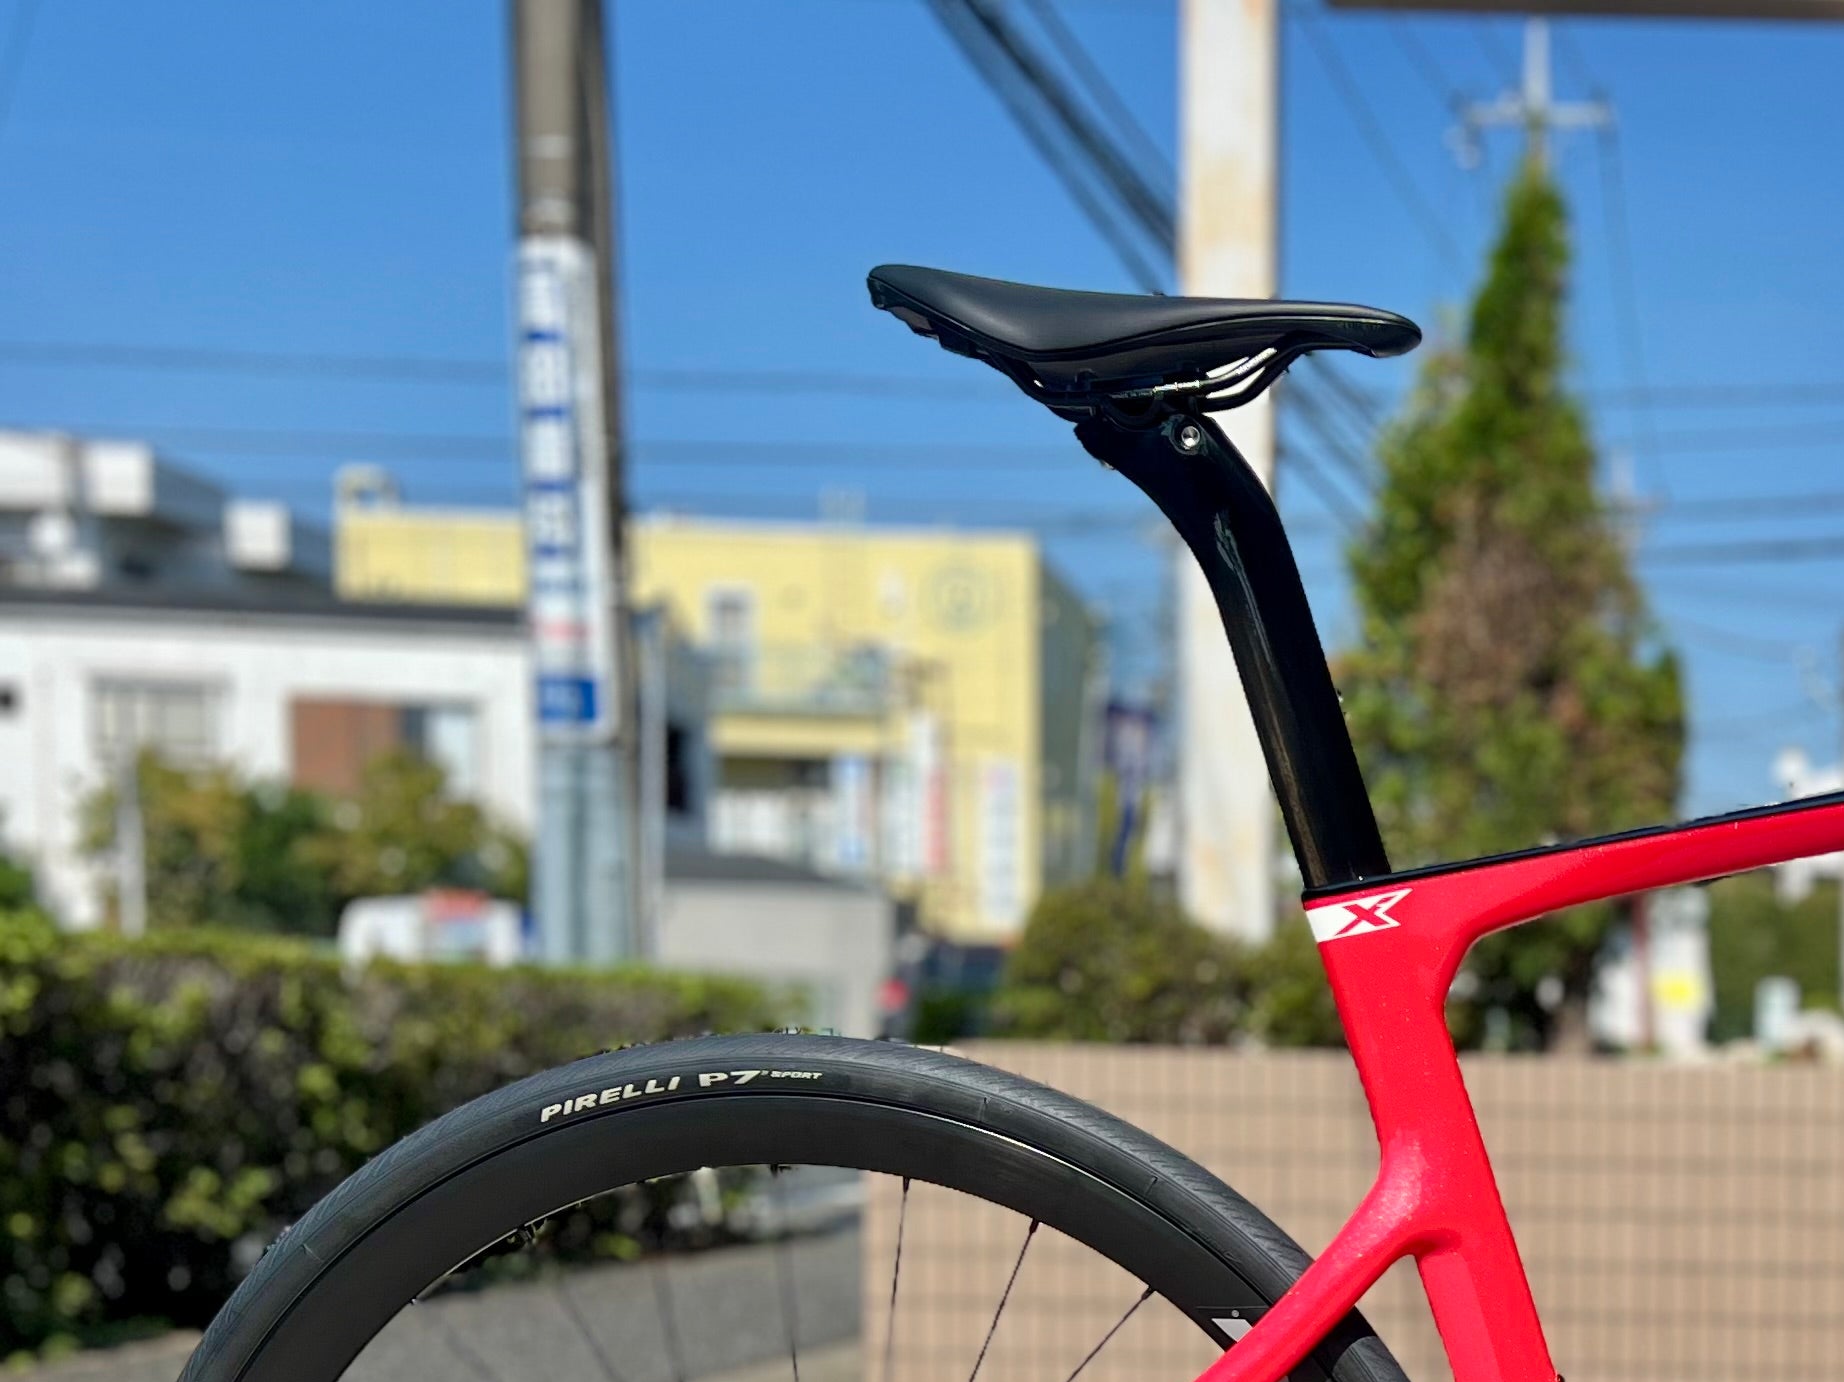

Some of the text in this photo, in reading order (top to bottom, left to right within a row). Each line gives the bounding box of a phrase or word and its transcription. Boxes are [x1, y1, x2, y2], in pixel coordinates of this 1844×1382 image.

[540, 1070, 823, 1123] PIRELLI P7 SPORT
